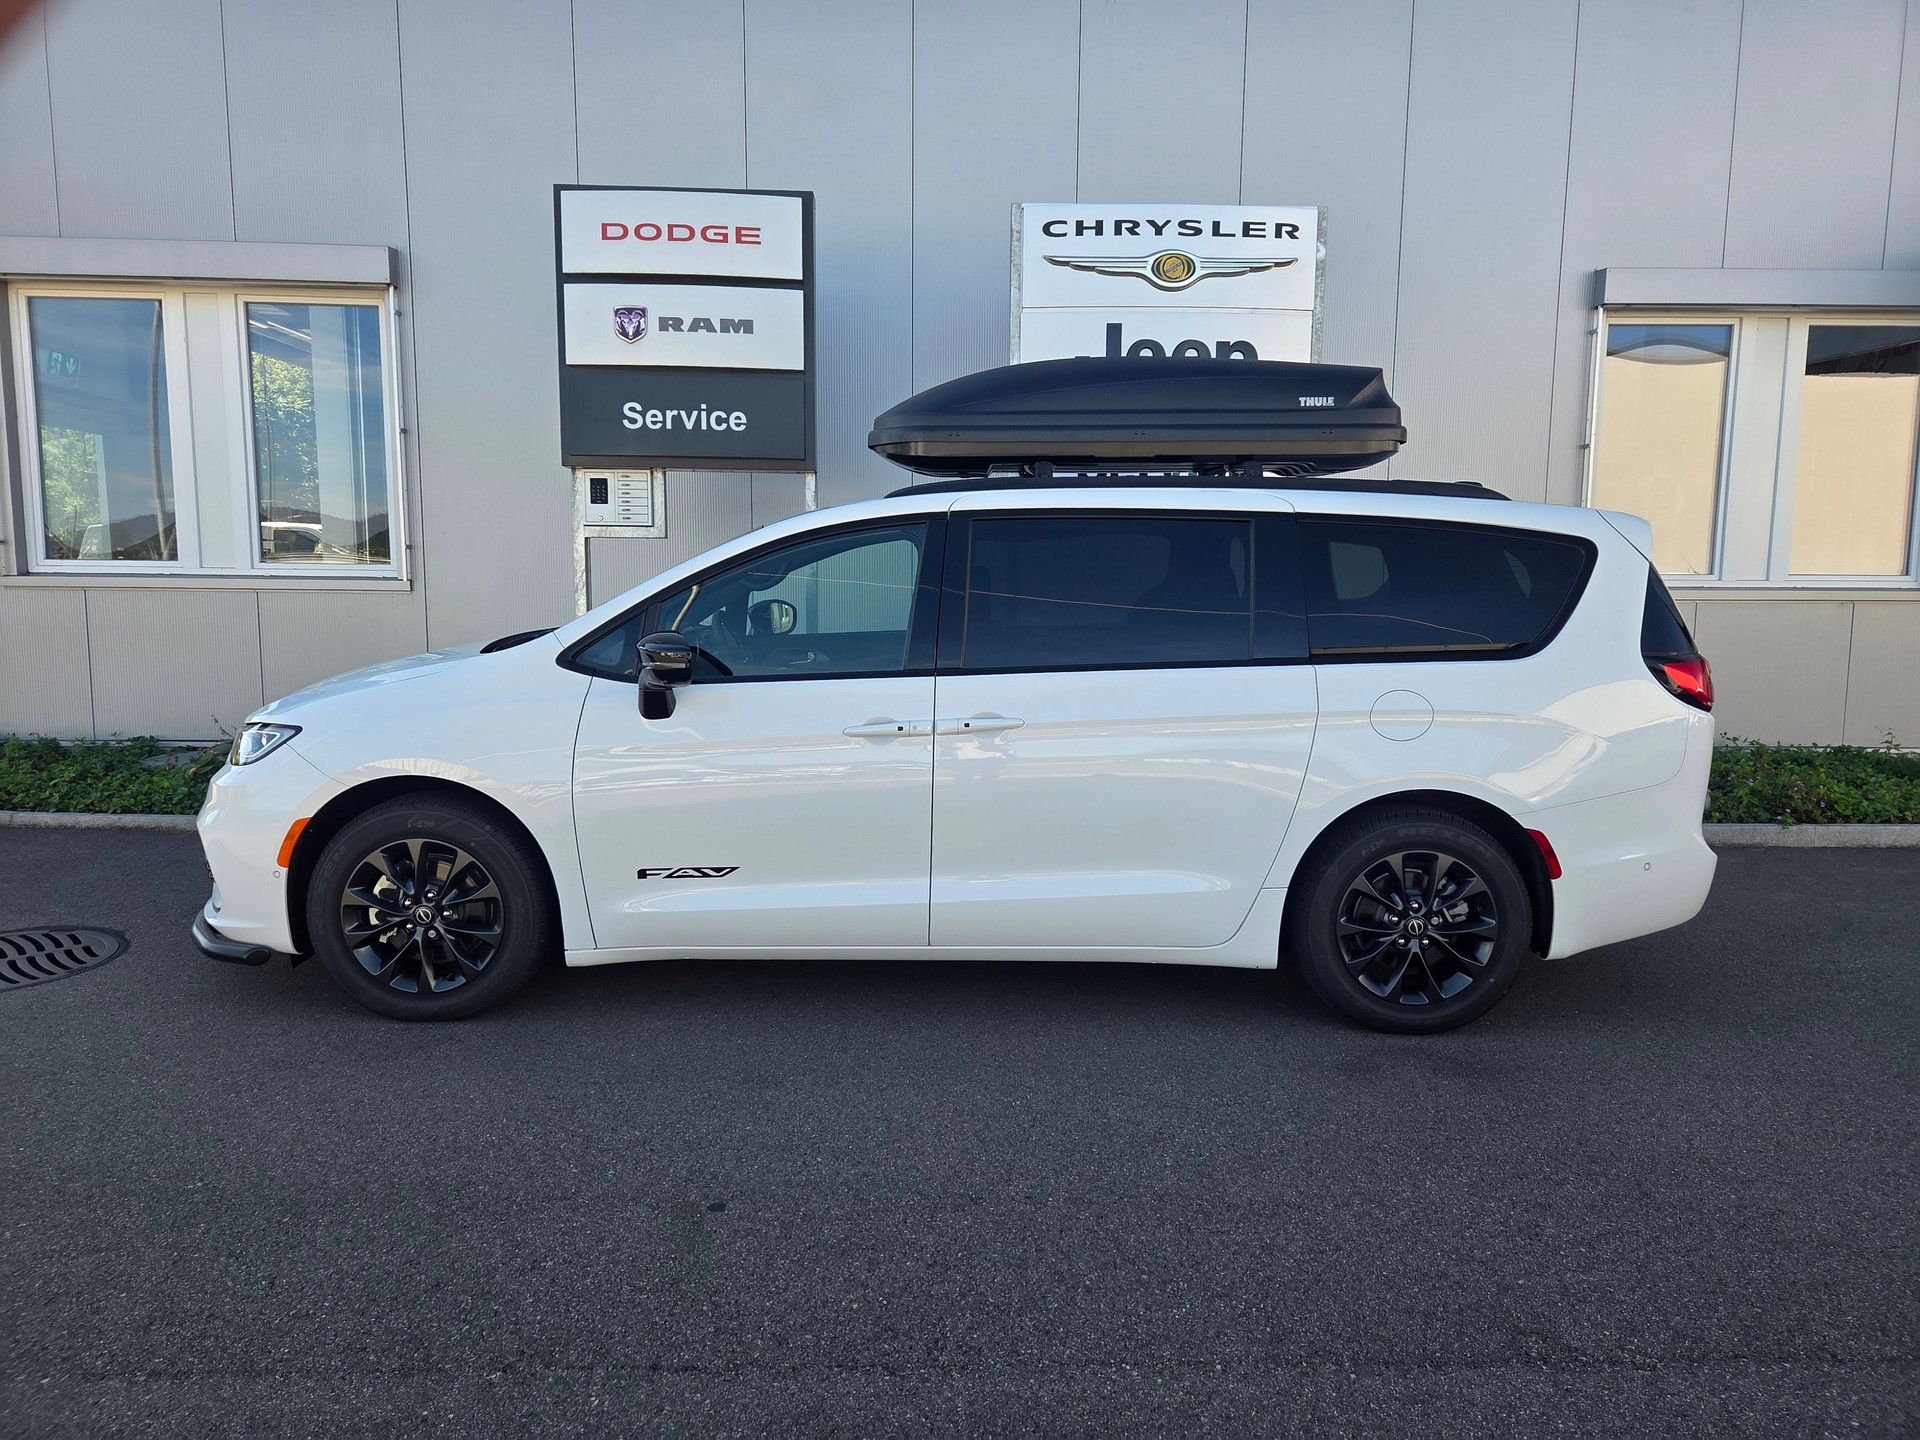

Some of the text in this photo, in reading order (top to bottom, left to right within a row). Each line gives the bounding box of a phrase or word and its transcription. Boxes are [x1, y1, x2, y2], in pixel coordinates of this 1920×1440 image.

[601, 222, 762, 245] DODGE
[1042, 219, 1300, 240] CHRYSLER
[658, 316, 754, 335] RAM
[1298, 396, 1335, 407] THULE
[622, 401, 748, 432] Service
[1397, 827, 1493, 858] NEXEN
